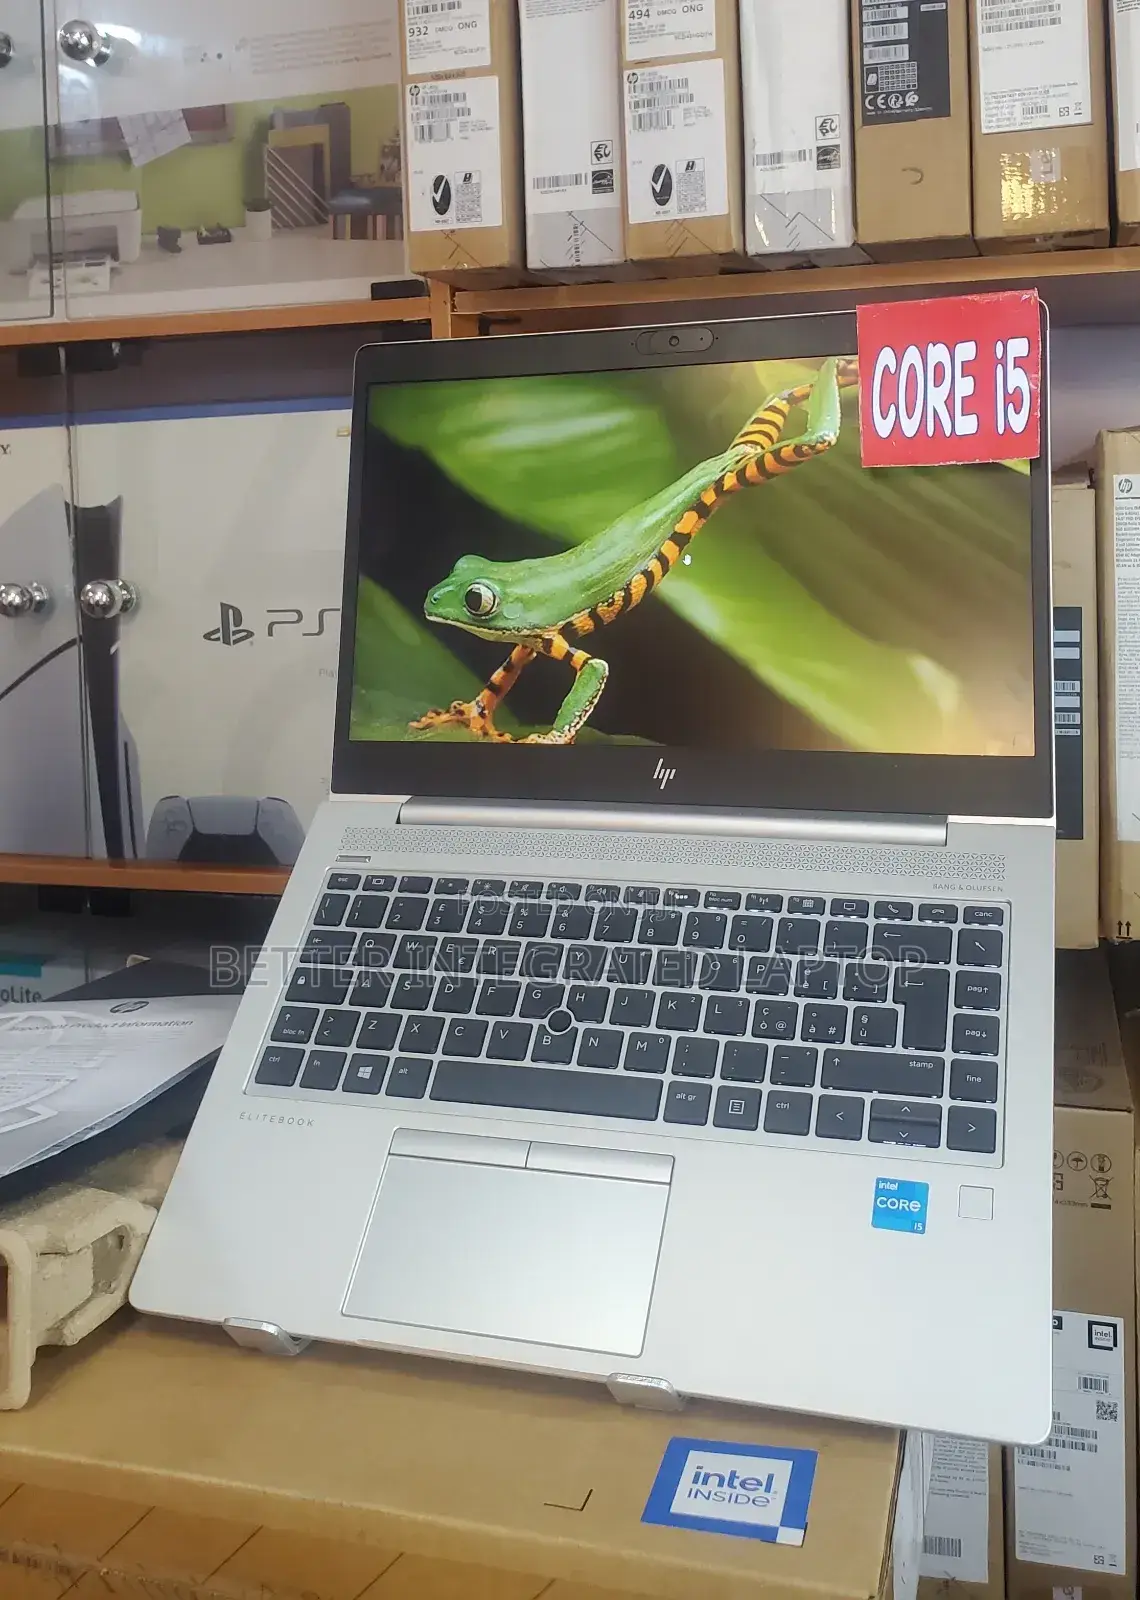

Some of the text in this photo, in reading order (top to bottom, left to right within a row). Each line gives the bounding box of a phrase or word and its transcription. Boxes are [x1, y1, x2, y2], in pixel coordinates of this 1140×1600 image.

[628, 9, 650, 20] 494
[682, 4, 703, 13] ONG
[408, 26, 429, 37] 932
[457, 20, 477, 30] ONG
[871, 337, 1031, 439] CORE i5
[653, 758, 677, 790] hp
[965, 884, 1003, 892] OLUFSEN
[776, 1021, 786, 1030] @
[676, 1092, 686, 1100] alt
[239, 1111, 315, 1127] ELITEBOOK
[878, 1181, 899, 1190] intel
[691, 1466, 775, 1494] intel
